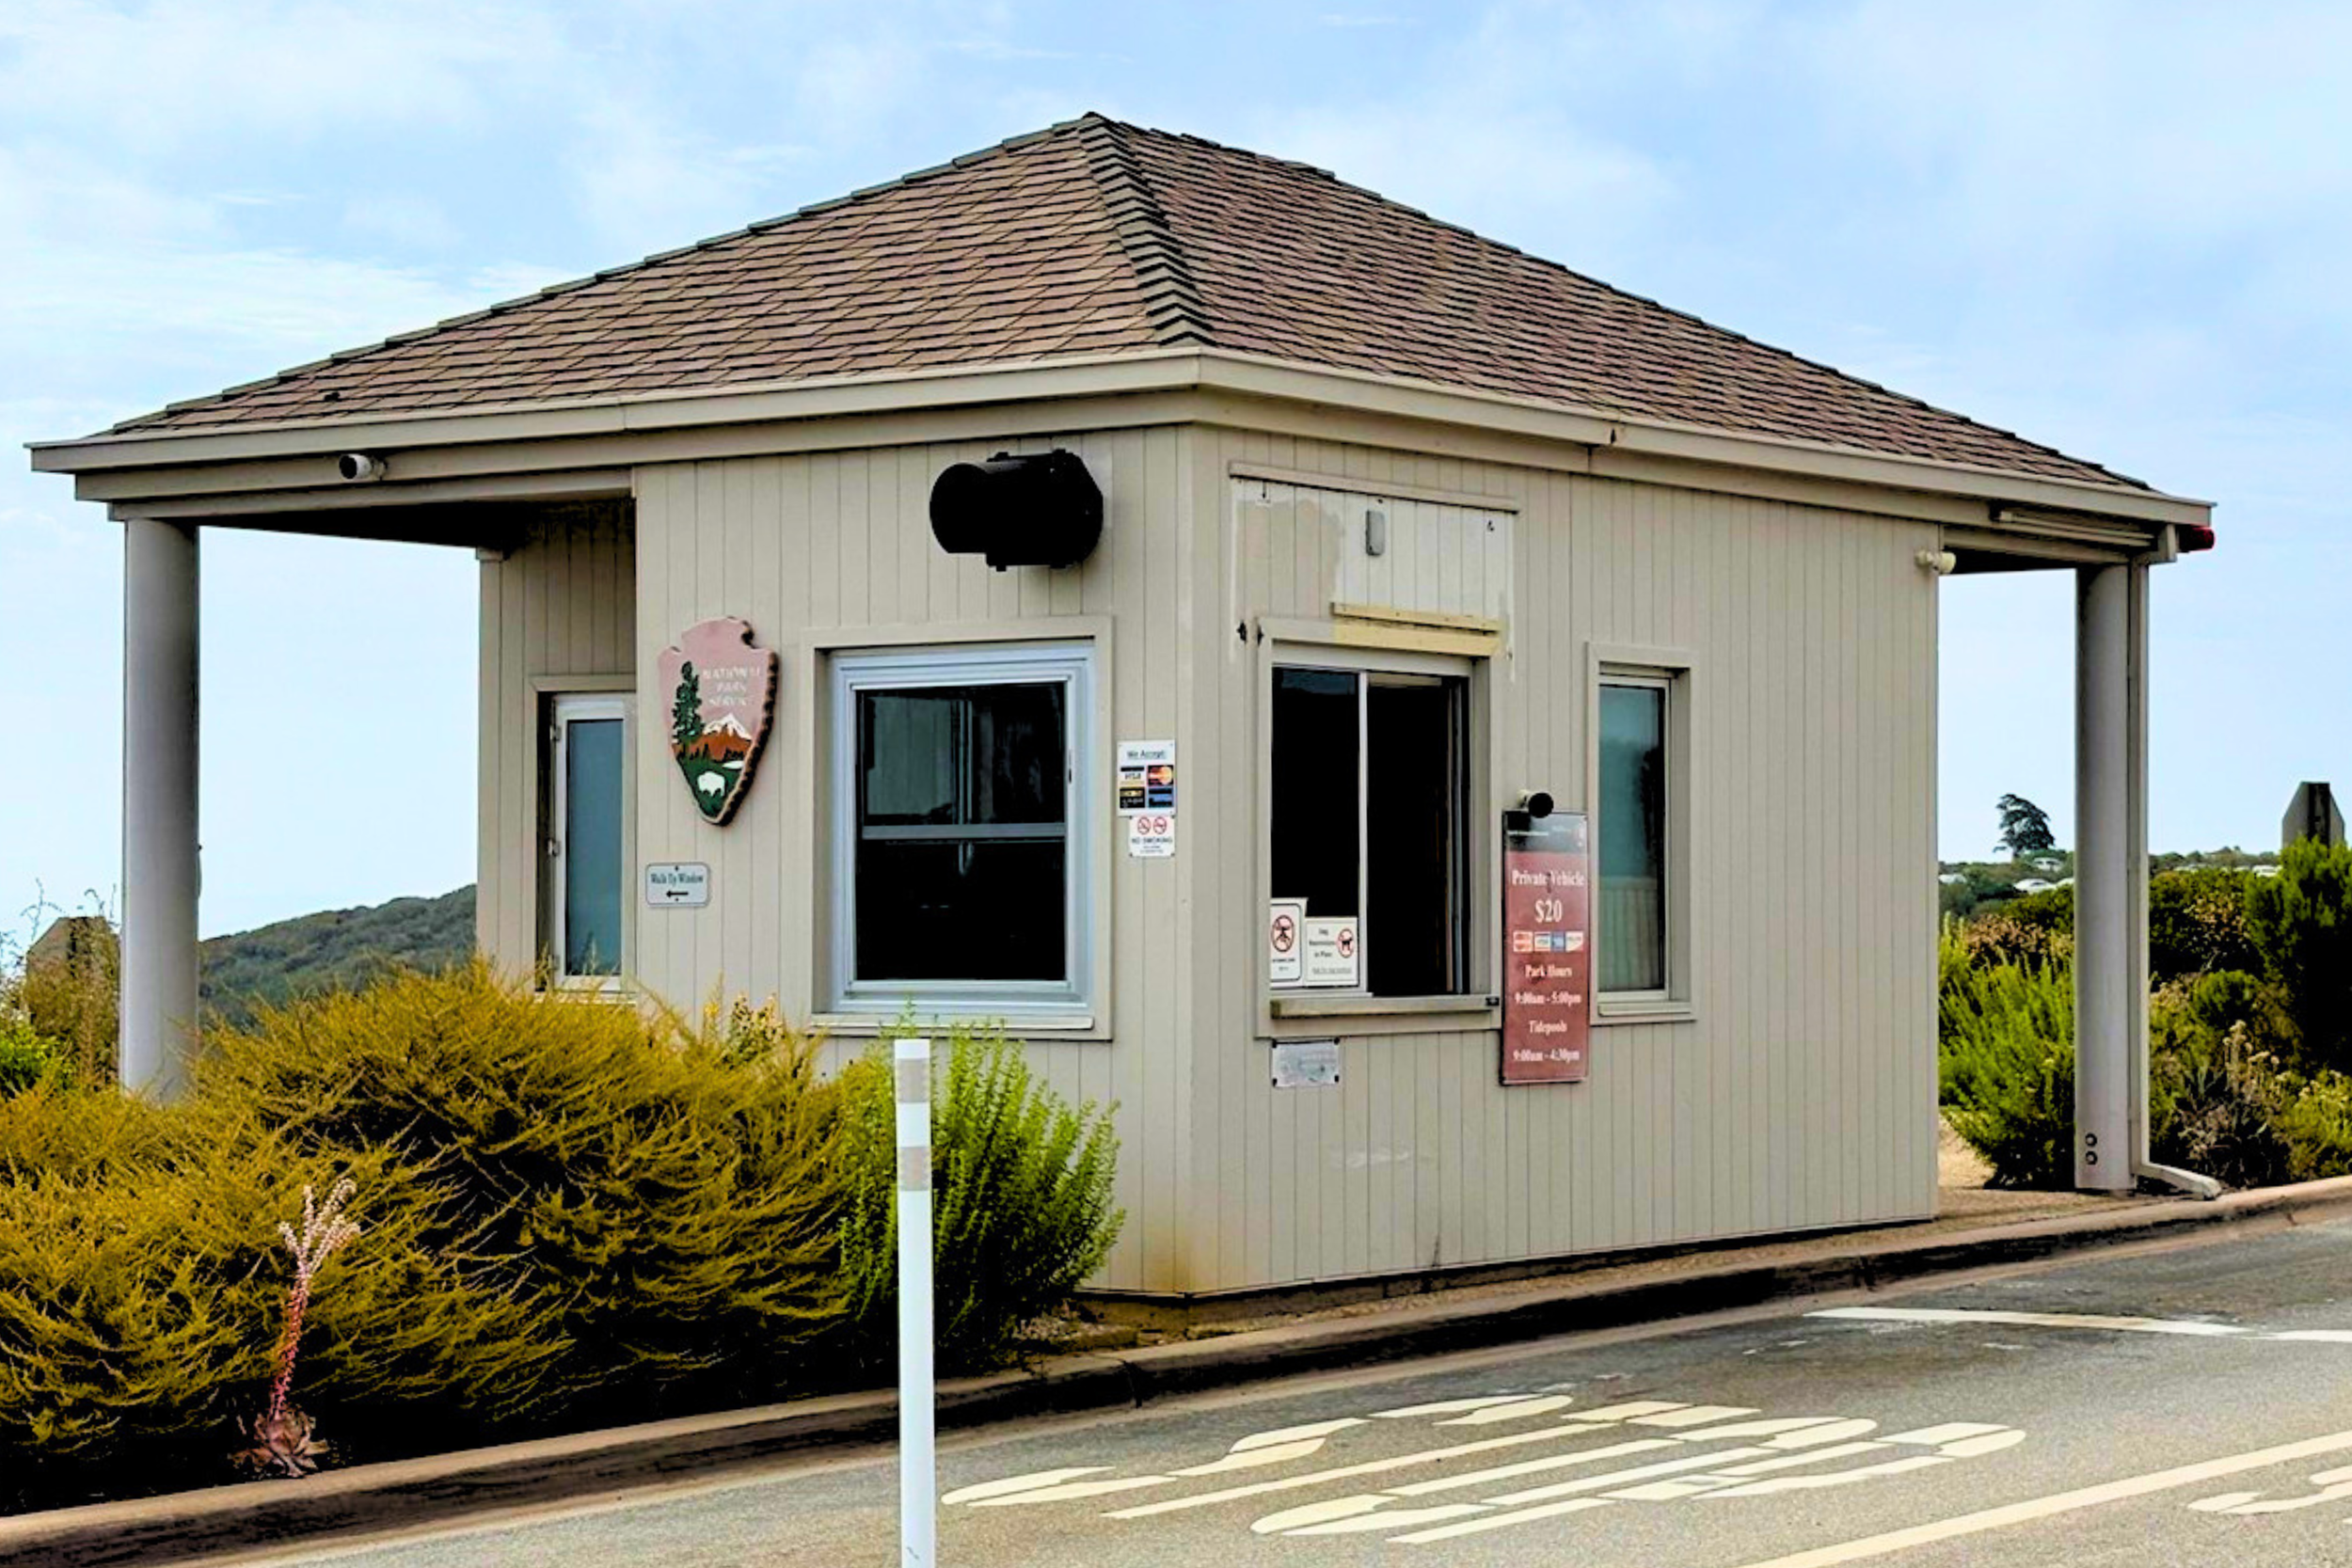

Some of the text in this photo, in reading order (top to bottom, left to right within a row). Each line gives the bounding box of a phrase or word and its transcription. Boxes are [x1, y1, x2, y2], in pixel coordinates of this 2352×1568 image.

[650, 873, 667, 884] Walk
[677, 871, 704, 884] Window
[1511, 868, 1585, 886] Private Vehicle
[1534, 898, 1563, 923] $20
[1525, 964, 1573, 977] Park Hours
[1529, 1020, 1568, 1036] Tidepools
